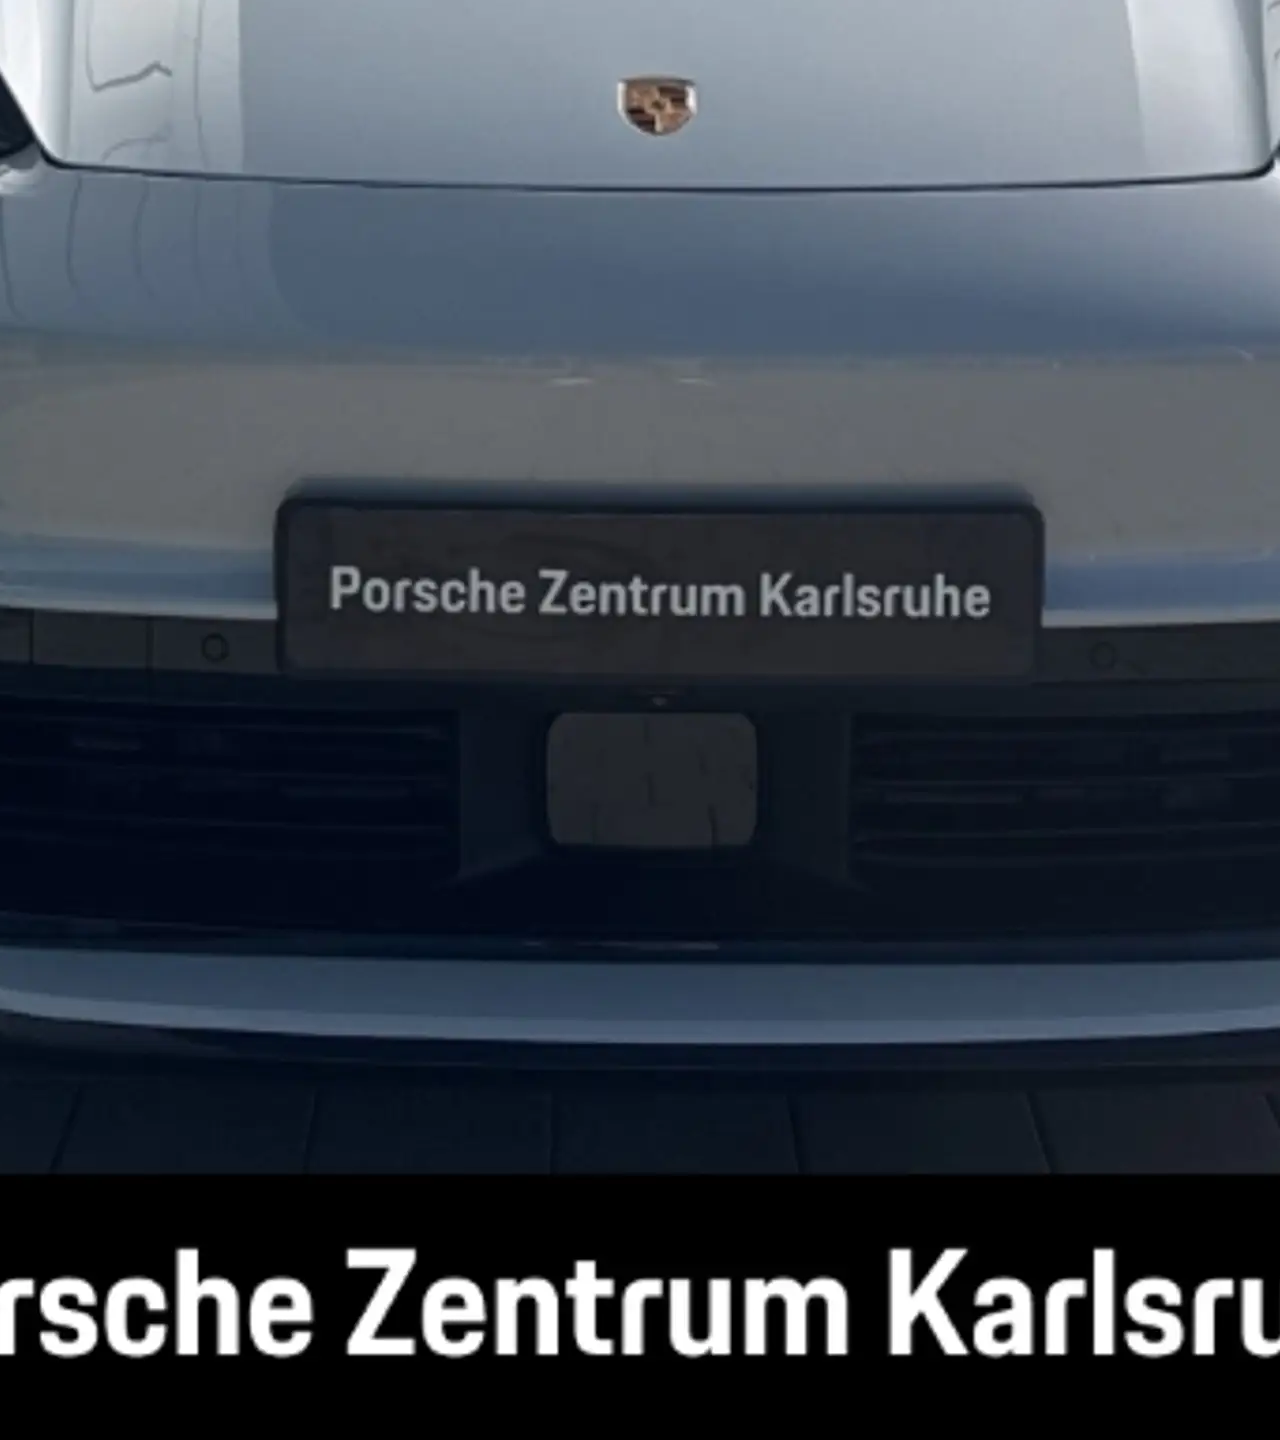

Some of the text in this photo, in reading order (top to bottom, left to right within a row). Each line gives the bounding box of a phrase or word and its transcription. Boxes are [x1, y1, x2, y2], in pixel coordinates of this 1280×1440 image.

[330, 566, 991, 618] Porsche Zentrum Karlsruhe
